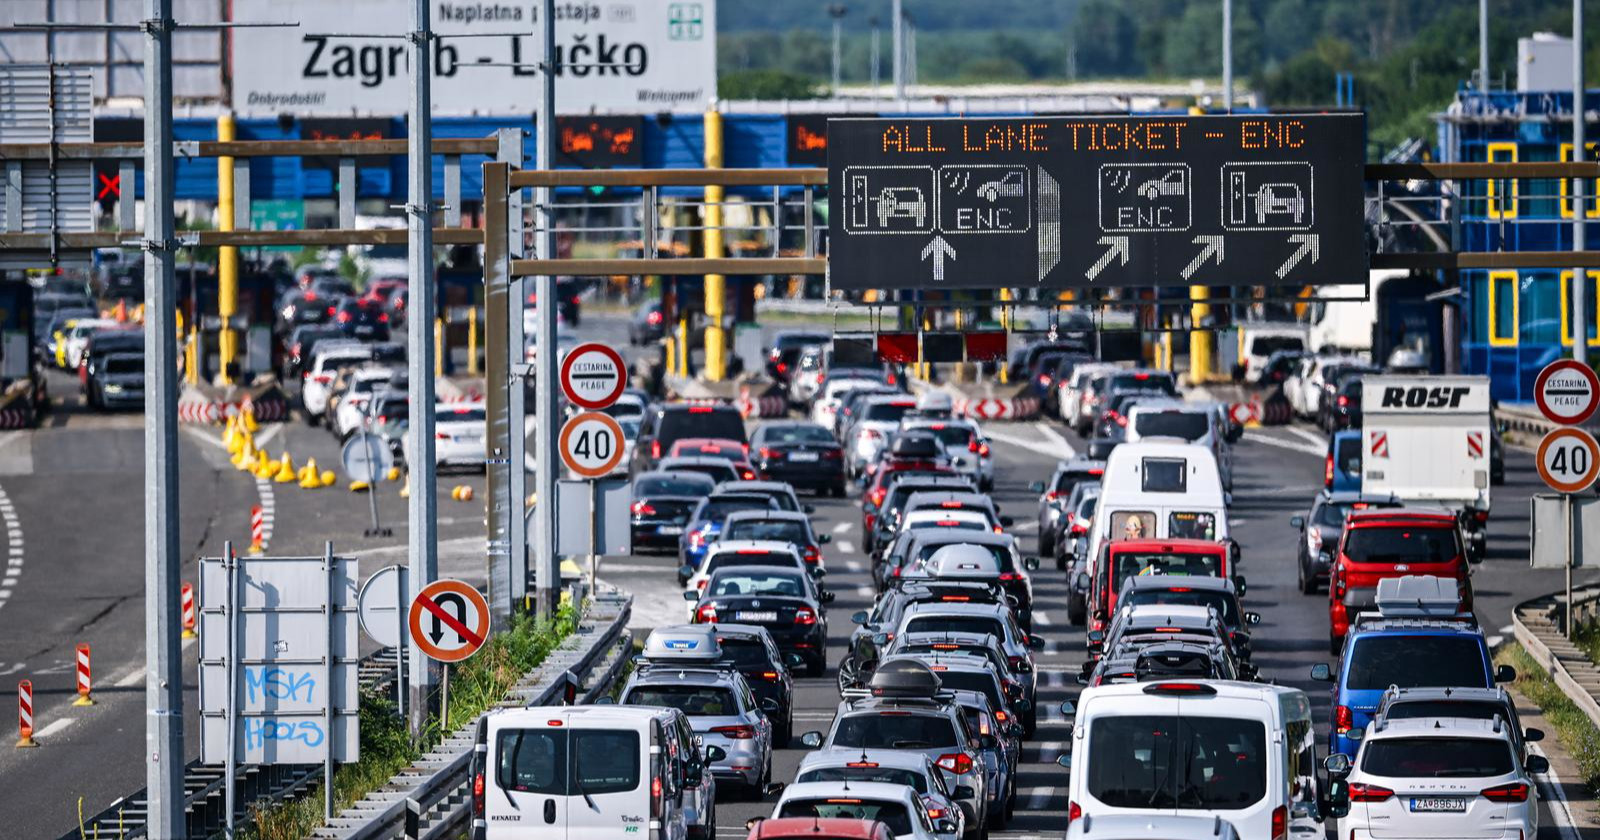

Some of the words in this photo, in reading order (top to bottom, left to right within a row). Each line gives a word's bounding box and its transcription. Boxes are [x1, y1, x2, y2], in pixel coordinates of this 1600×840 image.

[439, 4, 523, 24] Naplatna
[531, 4, 601, 24] pstaja
[303, 36, 458, 87] Zagrb
[882, 125, 946, 152] ALL
[963, 123, 1049, 152] LANE
[1065, 121, 1188, 151] TICKET
[1241, 120, 1305, 149] ENC
[956, 207, 1012, 230] ENC
[1117, 206, 1173, 228] ENC
[573, 363, 613, 372] CESTARINA
[1547, 379, 1588, 389] CESTARINA
[1381, 386, 1471, 409] ROST
[574, 430, 610, 460] 40
[1550, 445, 1588, 476] 40
[244, 666, 316, 704] MSK
[244, 716, 325, 751] HOOLS
